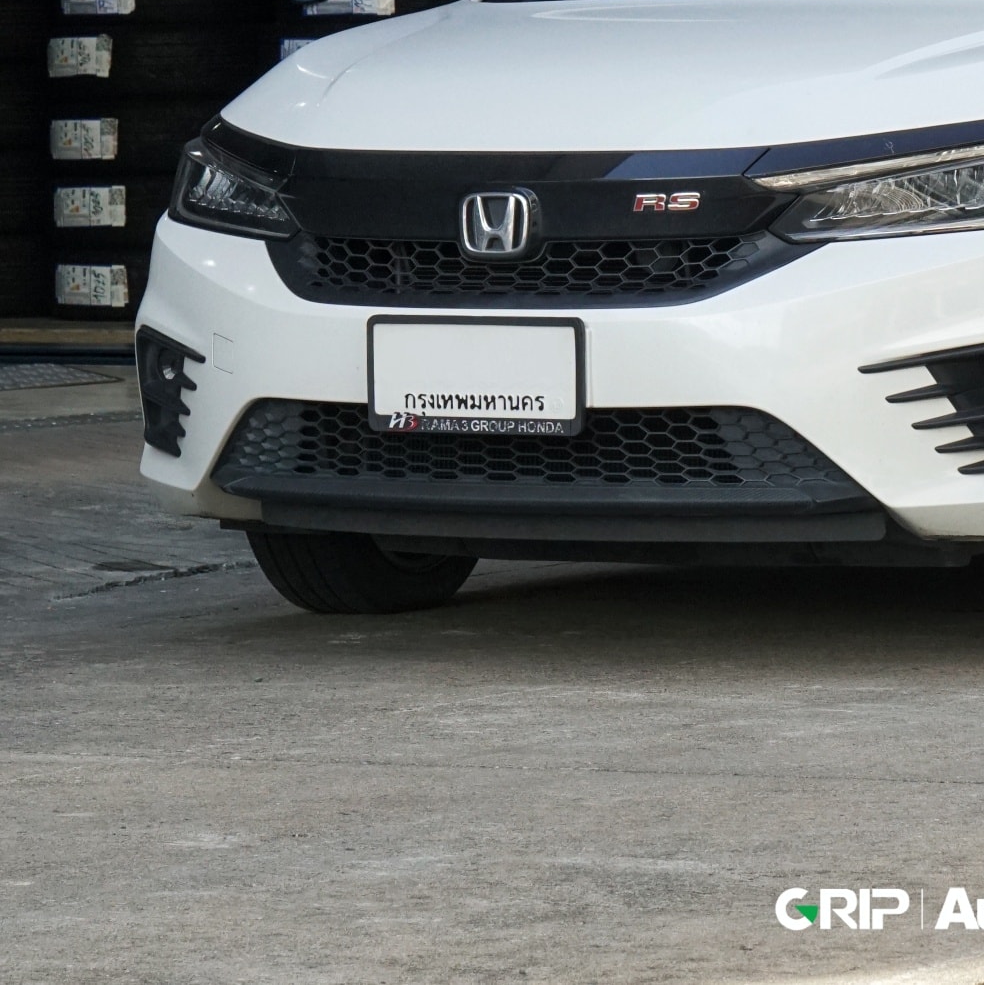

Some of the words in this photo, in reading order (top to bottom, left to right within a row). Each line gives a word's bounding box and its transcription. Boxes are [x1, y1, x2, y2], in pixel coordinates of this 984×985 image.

[633, 191, 701, 212] RS
[404, 393, 545, 416] กรุงเทพมหานคร
[461, 419, 469, 432] 3
[470, 420, 515, 433] GROUP
[518, 421, 564, 434] HONDA
